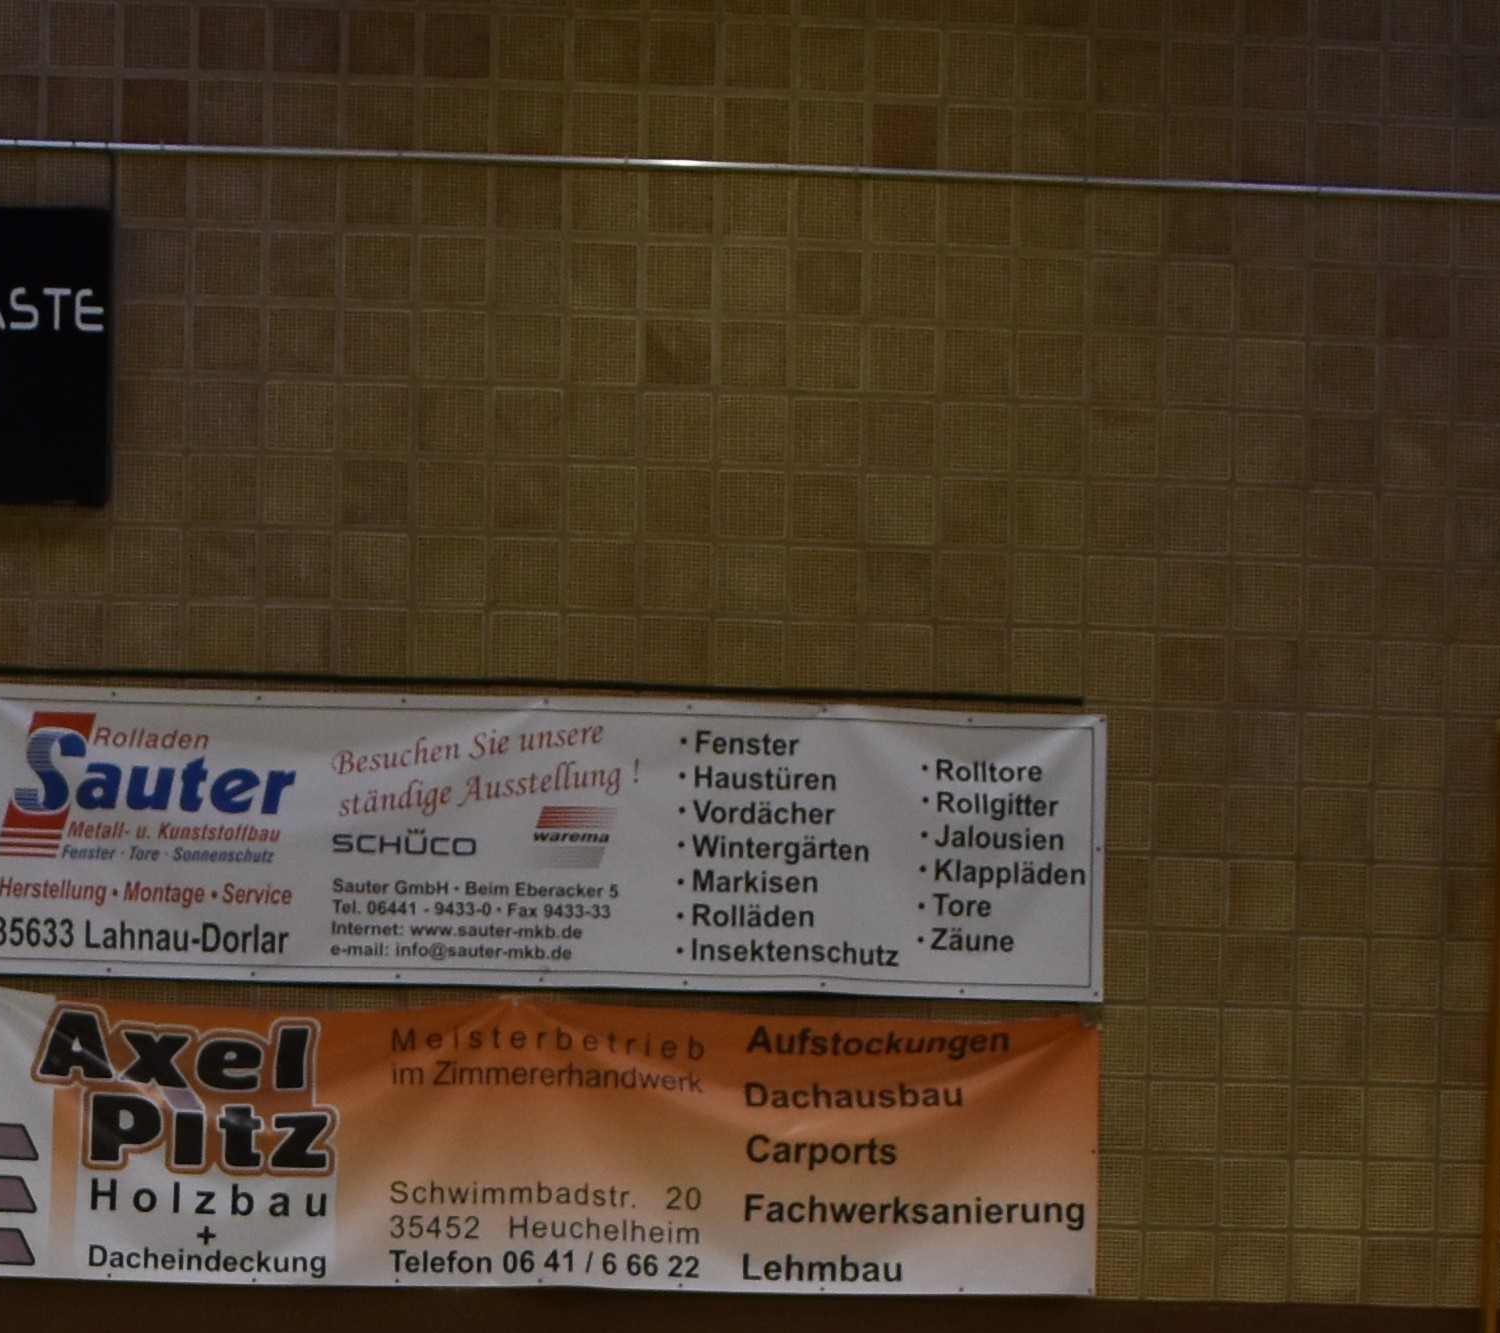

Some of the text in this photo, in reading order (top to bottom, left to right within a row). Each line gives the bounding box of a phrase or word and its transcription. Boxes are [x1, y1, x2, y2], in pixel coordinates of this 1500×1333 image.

[93, 727, 209, 749] Rolladen
[331, 724, 604, 775] Besuchen Sie unsere
[694, 730, 800, 757] Fenster
[13, 727, 296, 814] Sauter
[693, 765, 837, 791] Haustüren
[935, 759, 1043, 783] Rolltore
[338, 762, 623, 816] ständige Ausstellung
[693, 800, 836, 826] Vordächer
[936, 791, 1059, 821] Rollgitter
[67, 820, 281, 843] Metall- Kunststoffbau
[332, 828, 477, 856] SCHÜCO
[533, 831, 610, 844] warema
[934, 825, 1065, 851] Jalousien
[61, 843, 274, 863] Fenster Tore Sonnenschutz
[692, 834, 870, 865] Wintergärten
[692, 869, 819, 893] Markisen
[934, 858, 1087, 889] Klappläden
[123, 881, 205, 908] Montage
[222, 883, 292, 905] Service
[332, 879, 619, 897] Sauter GmbH Beim Eberacker 5
[691, 903, 815, 928] Rolläden
[933, 893, 991, 918] Tore
[85, 920, 290, 955] Lahnau-Dorlar
[331, 921, 583, 940] Internet: www.sauter-mkb.de
[930, 926, 1015, 953] Zäune
[330, 942, 572, 960] e-mail: info@sauter-mkb.de
[691, 939, 899, 967] Insektenschutz
[37, 1007, 313, 1091] Axel
[390, 1024, 706, 1061] Meisterbetrieb
[745, 1025, 1010, 1060] Aufstockungen
[392, 1060, 703, 1092] im Zimmererhandwerk
[744, 1082, 963, 1108] Dachausbau
[89, 1092, 333, 1169] Pitz
[745, 1134, 898, 1170] Carports
[90, 1177, 328, 1217] Holzbau
[390, 1180, 701, 1210] Schwimmbadstr. 20
[743, 1193, 1085, 1231] Fachwerksanierung
[389, 1214, 700, 1245] 35452 Heuchelheim
[88, 1244, 327, 1278] Dacheindeckung
[389, 1249, 493, 1274] Telefon
[742, 1253, 903, 1282] Lehmbau
